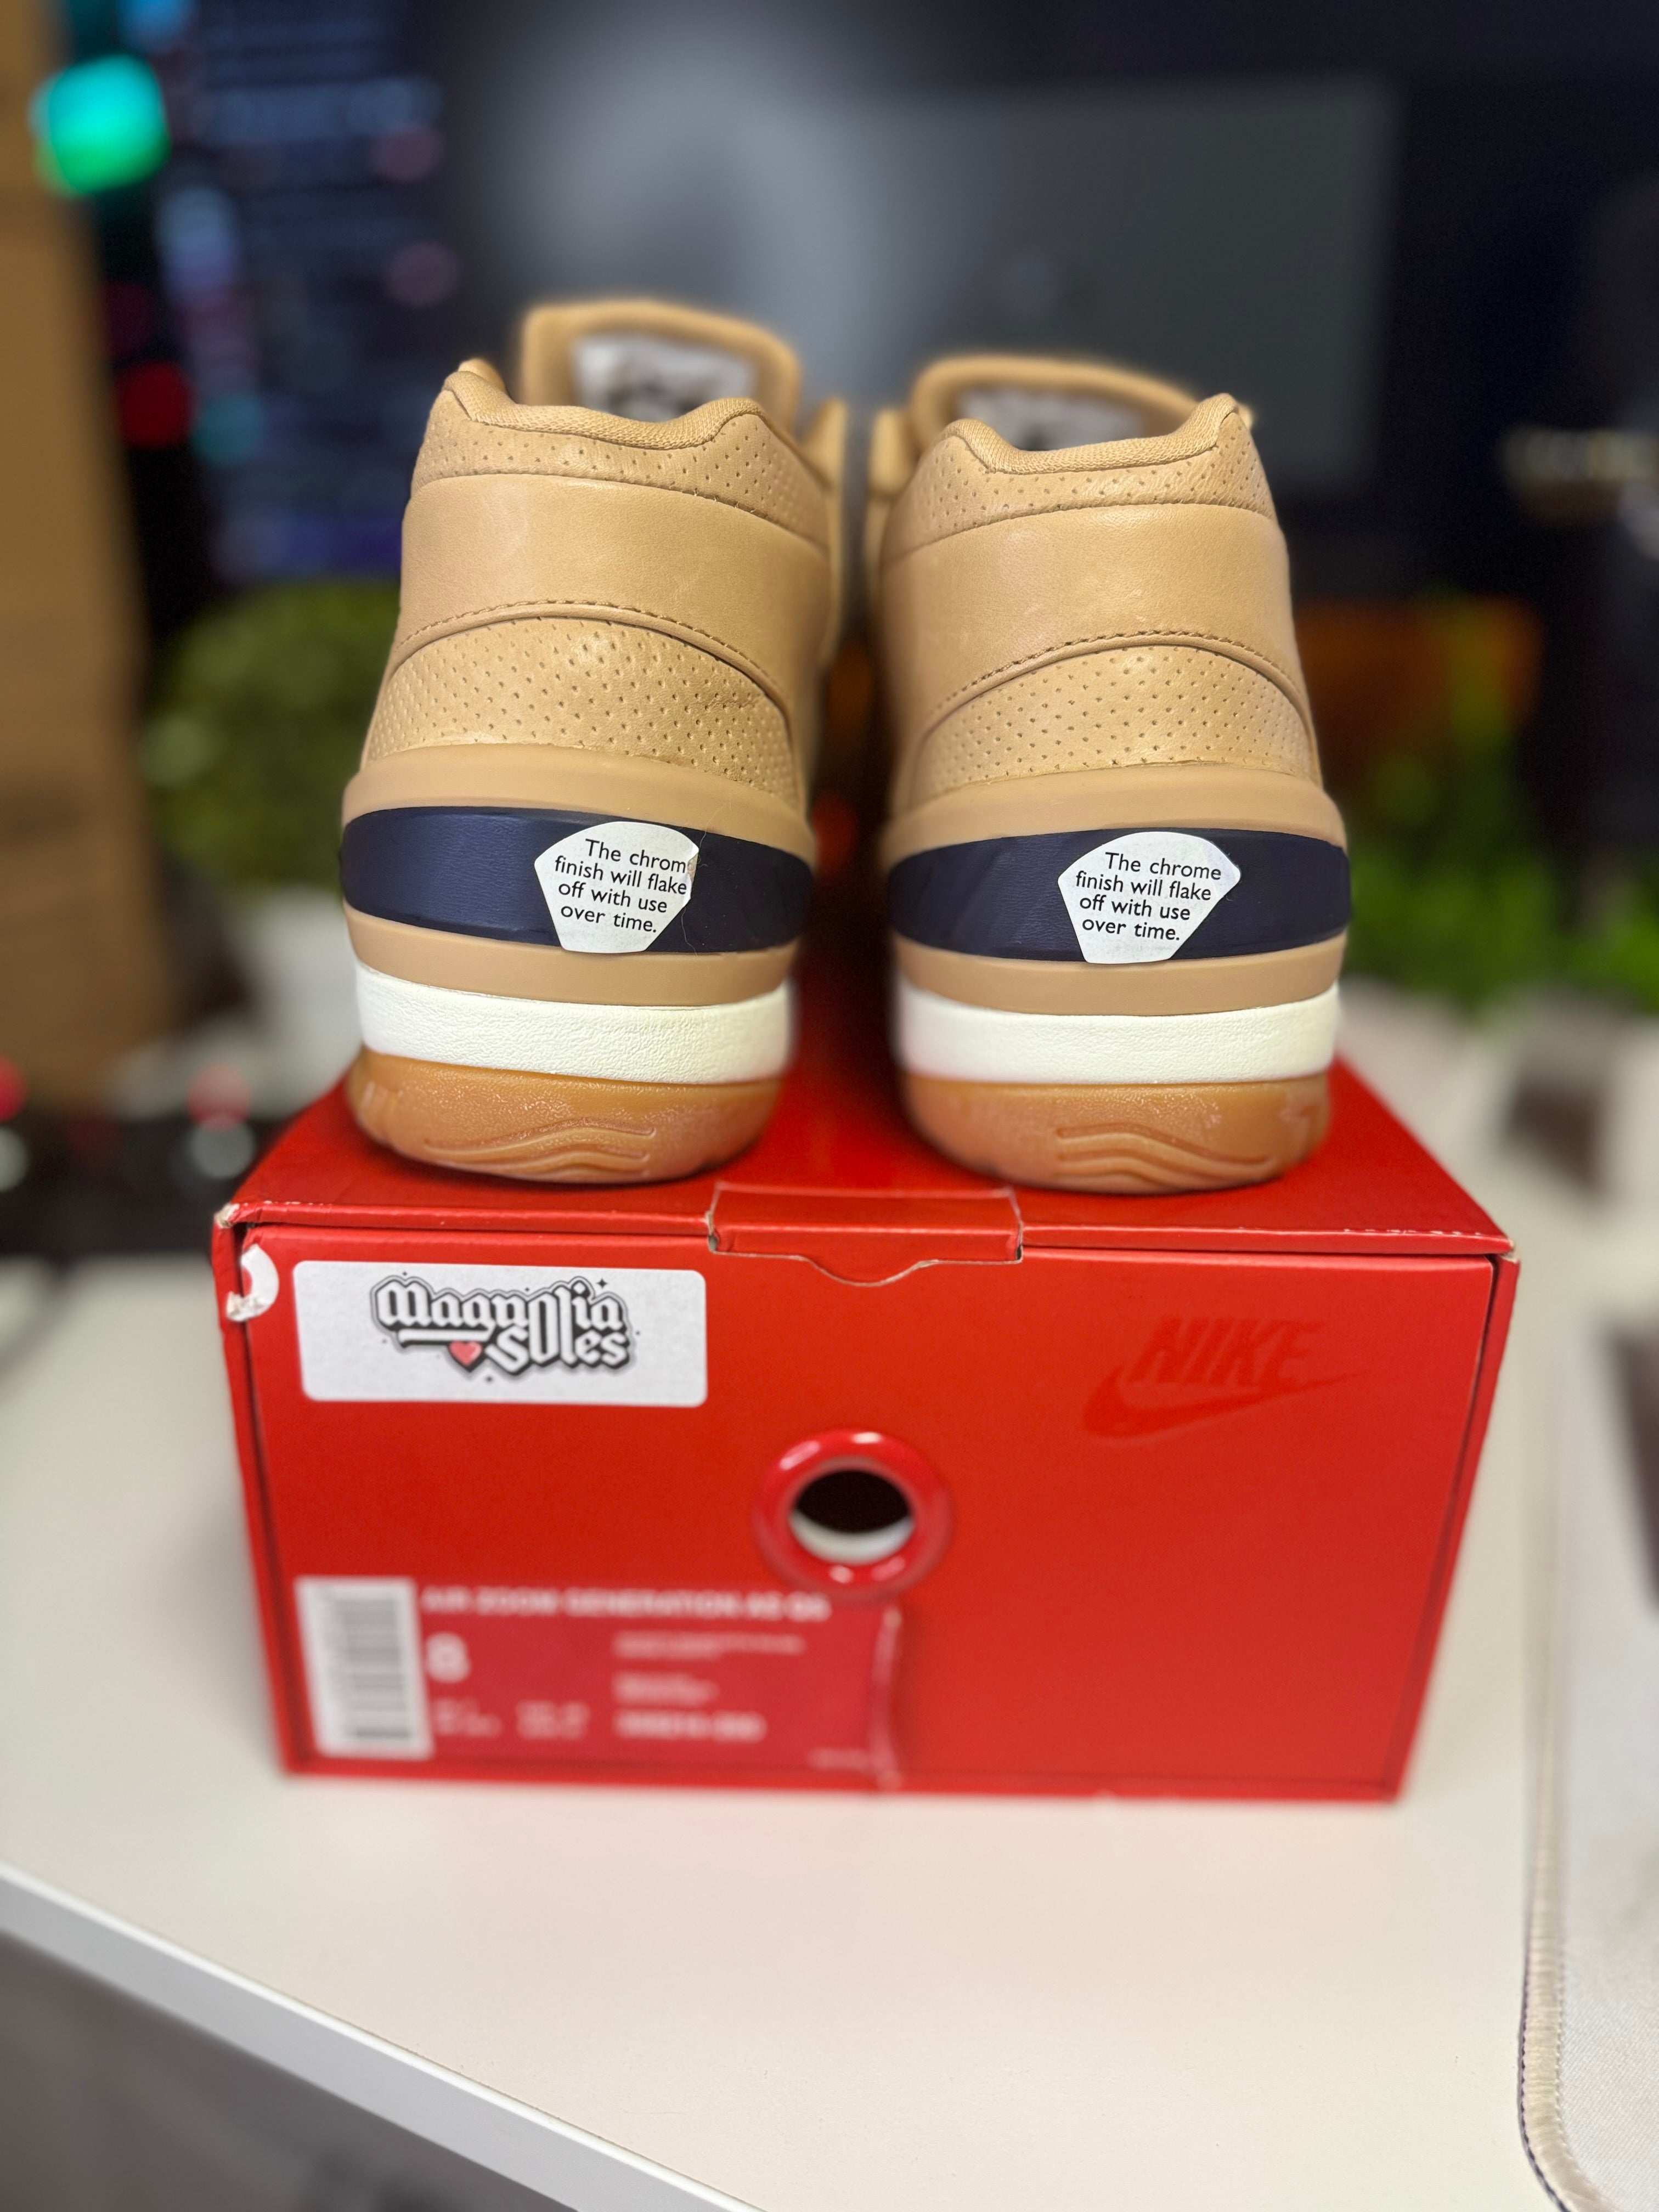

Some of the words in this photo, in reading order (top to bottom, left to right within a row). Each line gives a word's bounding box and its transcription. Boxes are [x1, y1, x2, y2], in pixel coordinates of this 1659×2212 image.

[585, 838, 621, 862] The
[630, 850, 686, 873] chrom
[1105, 852, 1141, 872] The
[1149, 858, 1221, 881] chrome
[555, 855, 603, 881] finish
[611, 870, 642, 888] will
[648, 873, 687, 895] flake
[1076, 870, 1124, 893] finish
[1131, 879, 1163, 896] will
[1169, 881, 1211, 901] flake
[558, 881, 586, 898] off
[591, 889, 631, 907] with
[638, 898, 667, 913] use
[1080, 894, 1107, 911] off
[1111, 899, 1152, 917] with
[1159, 905, 1190, 921] use
[561, 906, 606, 923] over
[613, 913, 656, 933] time.
[1082, 918, 1127, 934] over
[1134, 922, 1180, 941] time.
[1128, 1314, 1325, 1389] NIKE
